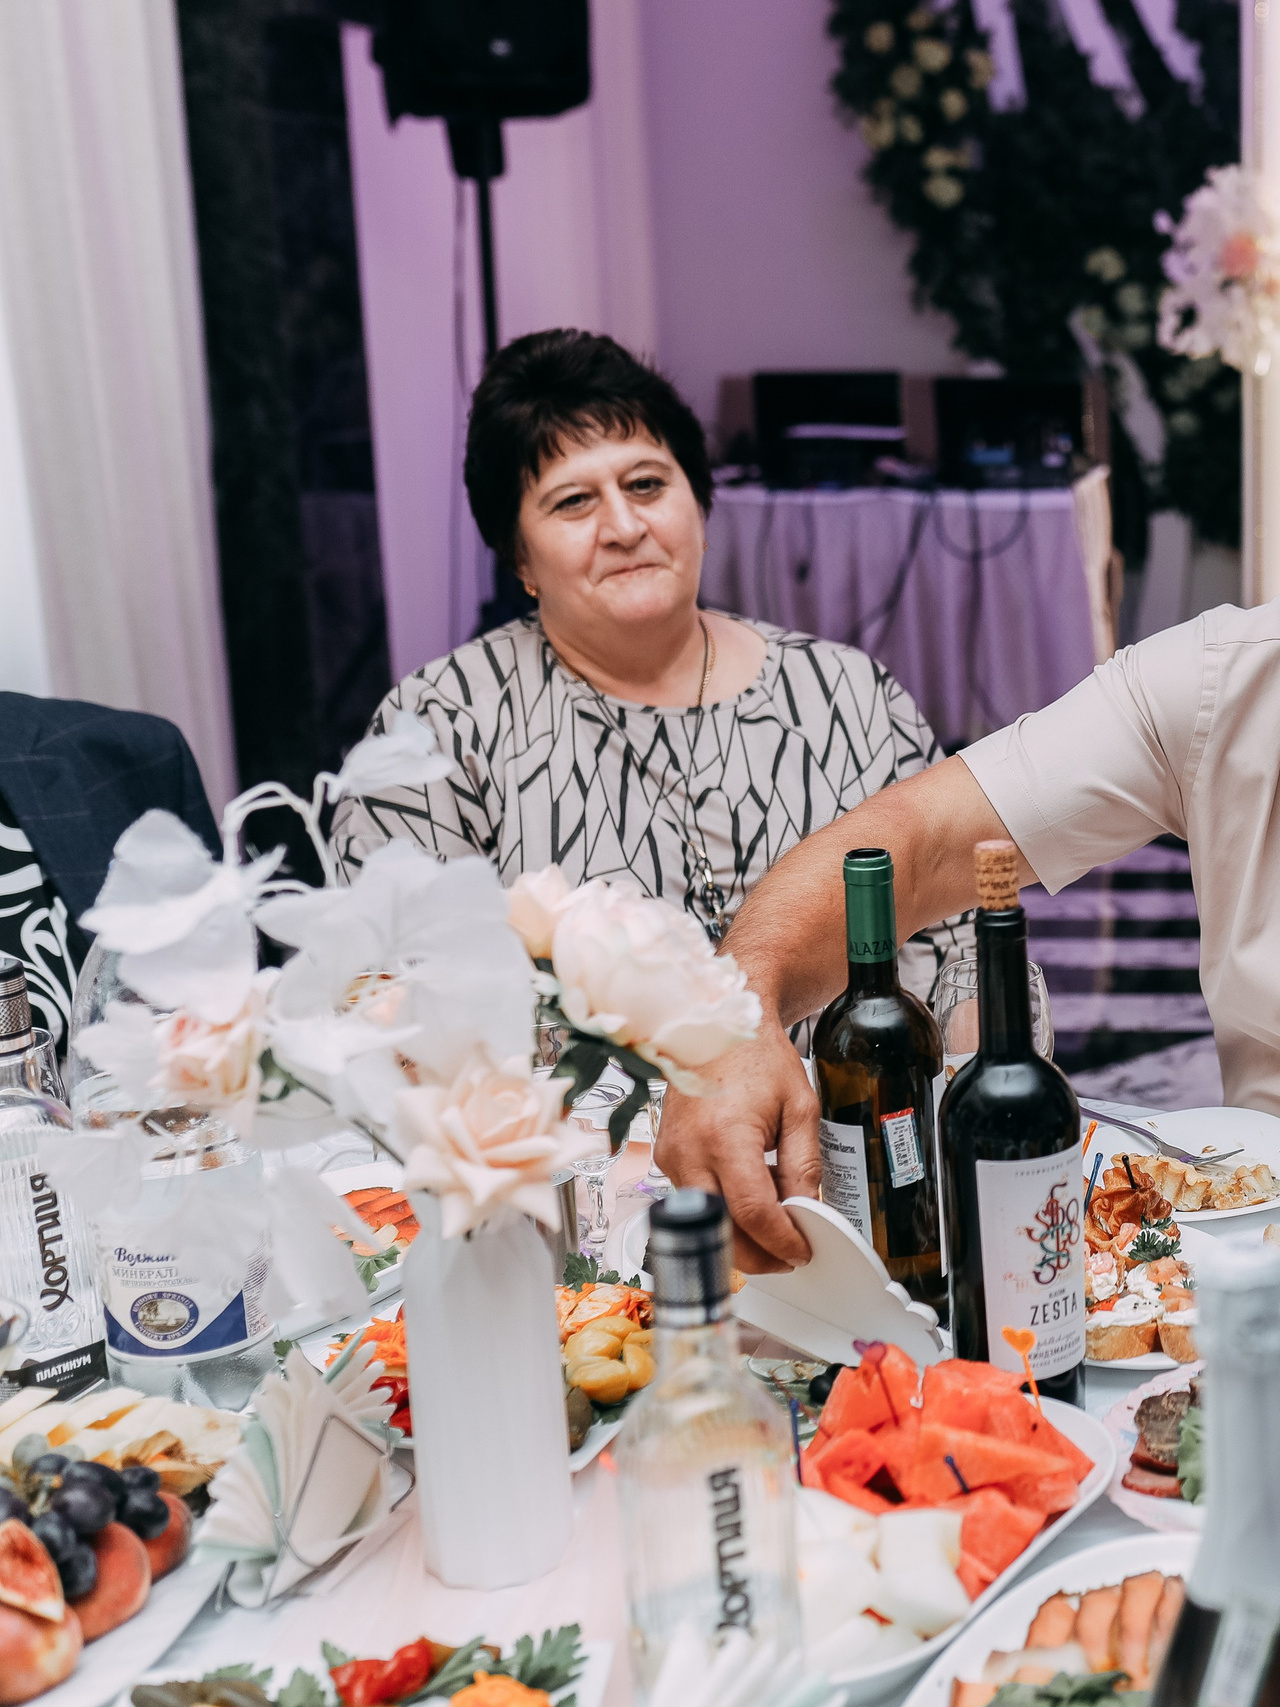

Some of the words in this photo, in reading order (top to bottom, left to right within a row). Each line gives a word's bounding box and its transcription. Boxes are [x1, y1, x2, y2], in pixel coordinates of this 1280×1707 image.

[162, 1293, 194, 1309] SPRINGS
[1030, 1291, 1078, 1327] ZESTA
[166, 1318, 195, 1341] SPRINGS
[35, 1353, 92, 1383] ПЛАТИНУМ
